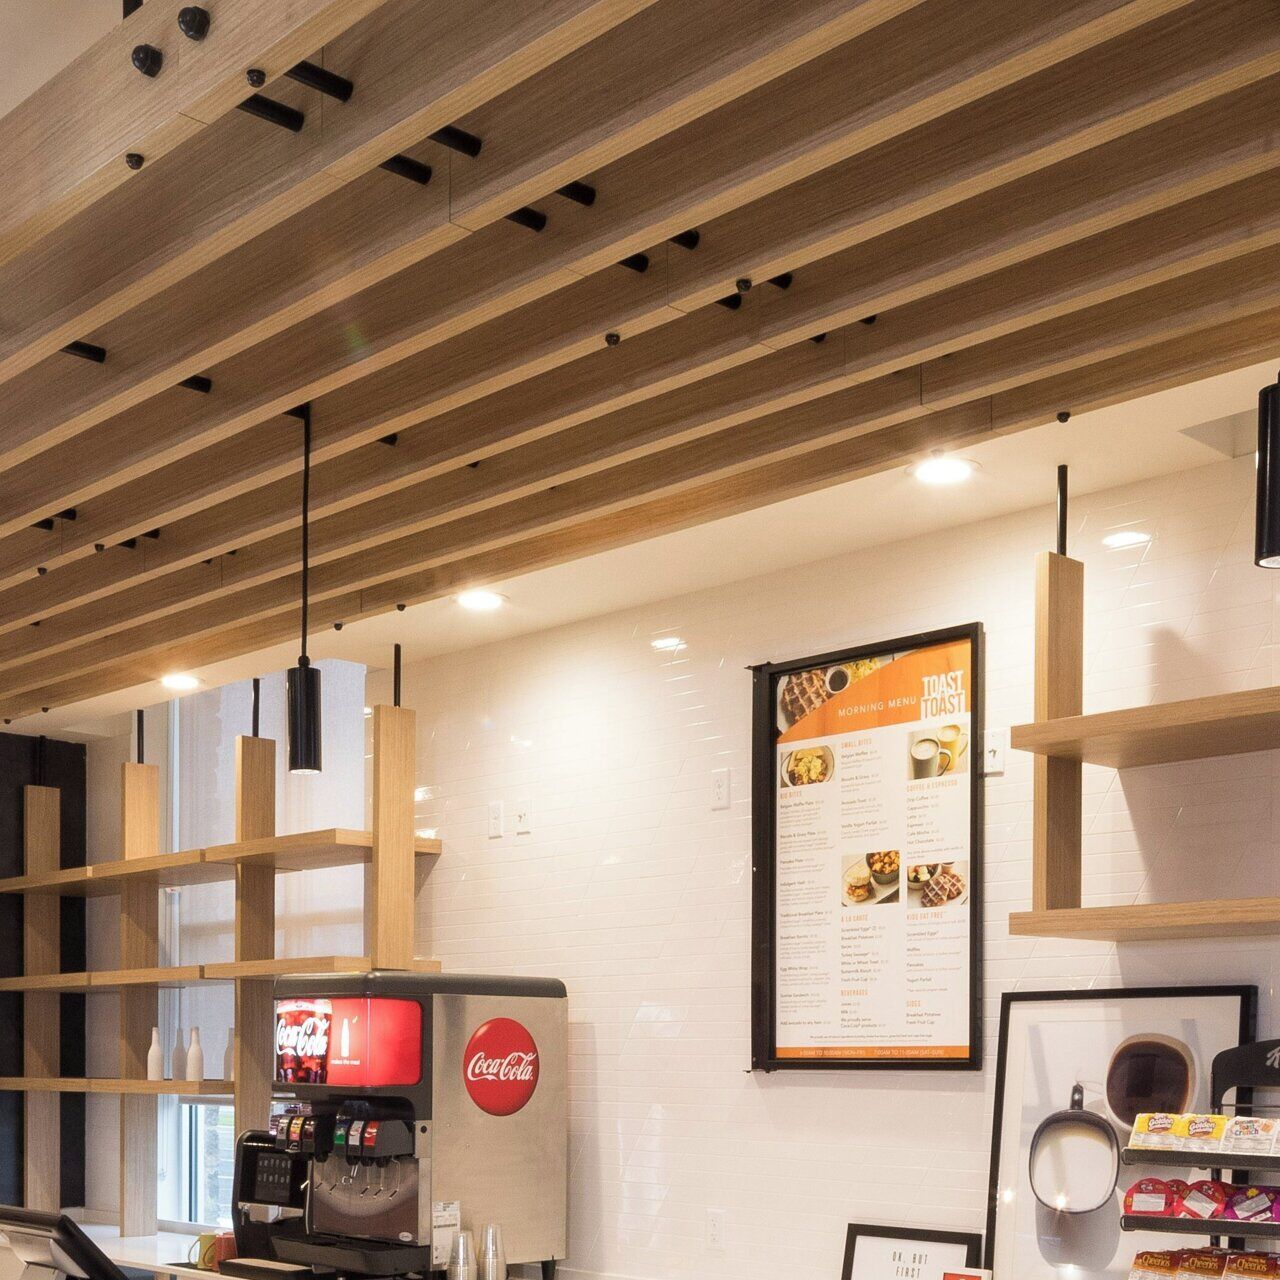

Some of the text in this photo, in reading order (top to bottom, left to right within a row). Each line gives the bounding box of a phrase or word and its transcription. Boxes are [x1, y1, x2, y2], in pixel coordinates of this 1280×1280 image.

[921, 670, 964, 699] TOAST
[838, 695, 917, 717] MORNING MENU
[920, 690, 966, 720] TOAST
[466, 1052, 536, 1080] Coca-Cola
[912, 1253, 928, 1264] BUT
[1190, 1257, 1218, 1270] Cheerios
[1238, 1259, 1267, 1272] Cheerios
[896, 1266, 920, 1279] FIRST
